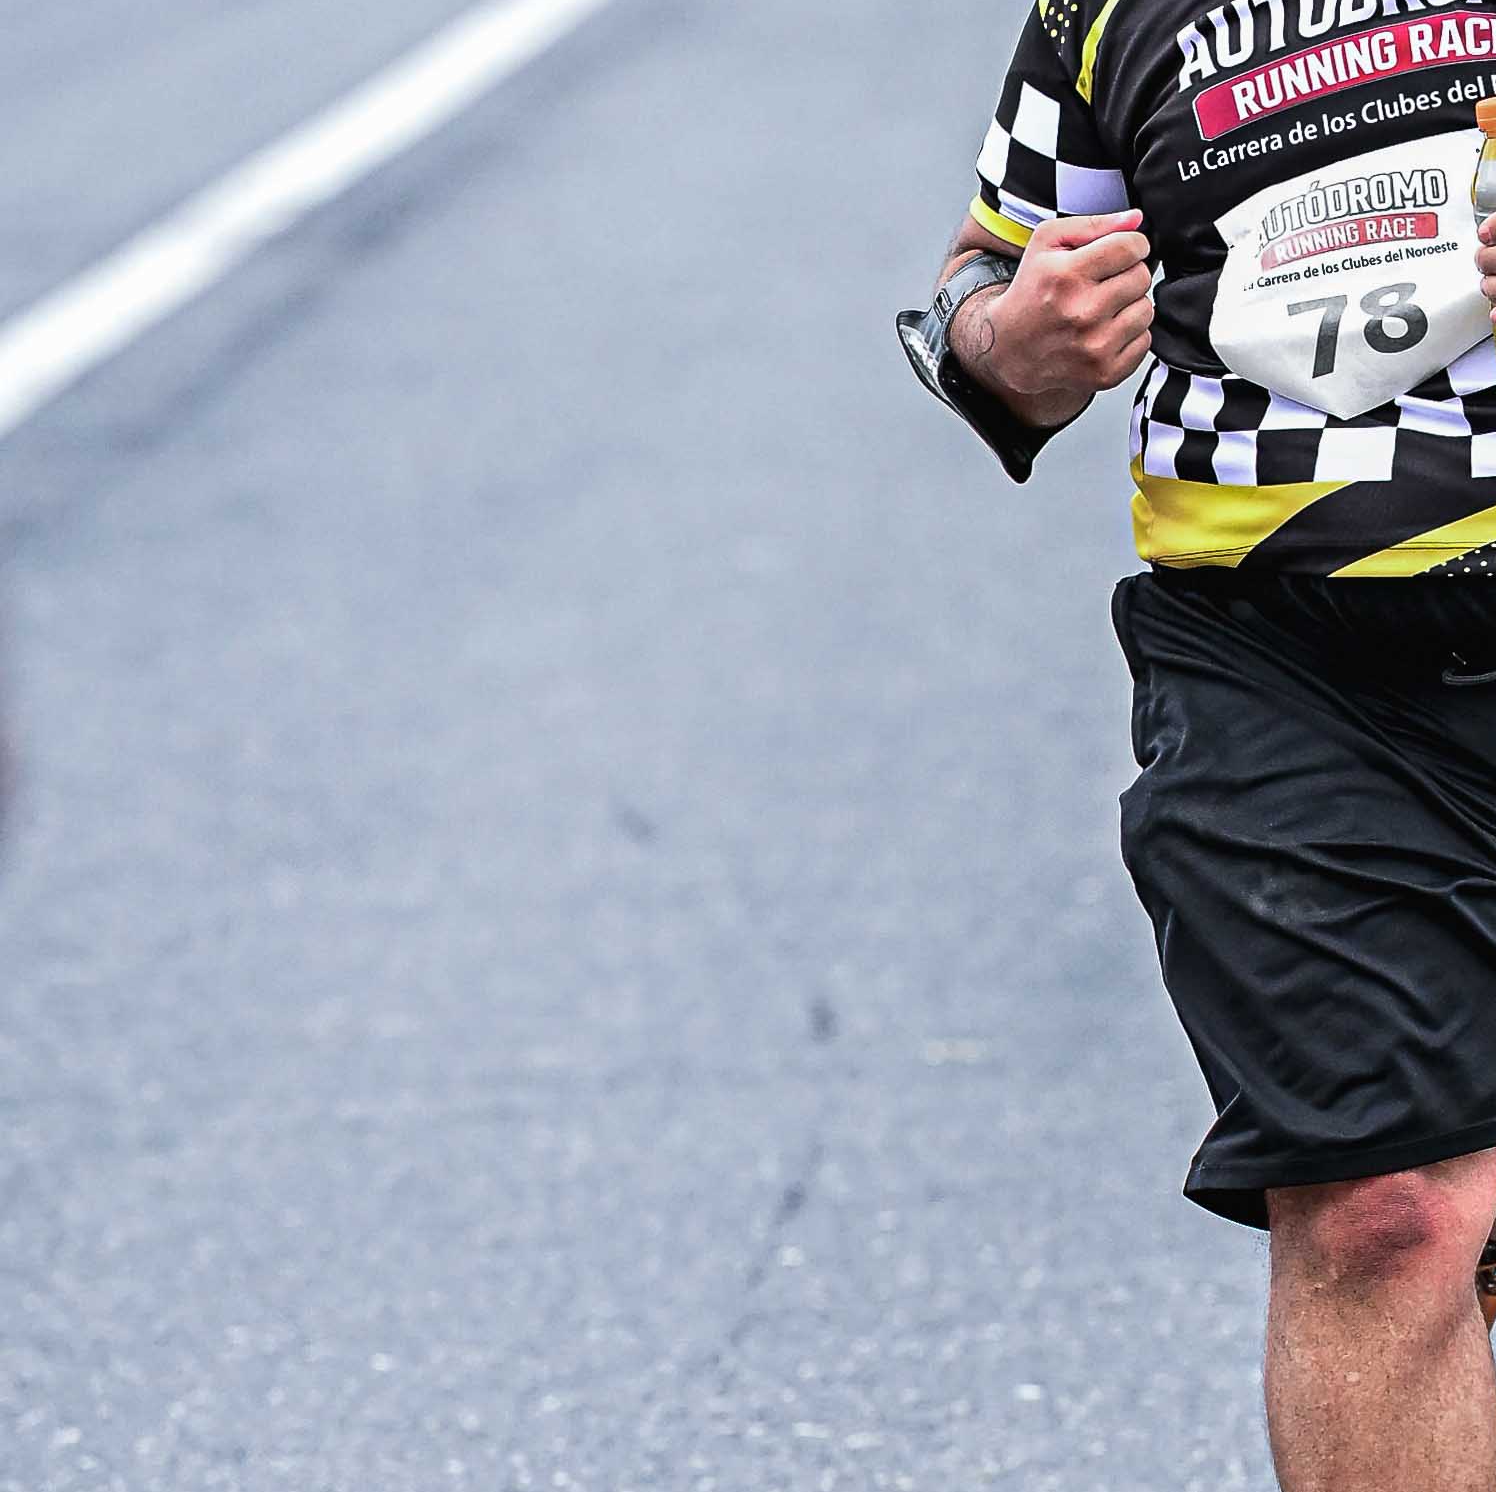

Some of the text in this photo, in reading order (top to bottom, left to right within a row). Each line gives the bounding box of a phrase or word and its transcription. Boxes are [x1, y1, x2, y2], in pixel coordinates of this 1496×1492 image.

[1231, 37, 1398, 121] RUNNING
[1178, 160, 1200, 181] La
[1203, 133, 1283, 170] Carrera
[1289, 120, 1318, 145] de
[1322, 112, 1357, 136] los
[1361, 90, 1442, 124] Clubes
[1447, 76, 1486, 103] del
[1257, 270, 1301, 288] Carrera
[1303, 266, 1320, 279] de
[1321, 262, 1339, 276] los
[1341, 254, 1382, 271] Clubes
[1384, 249, 1404, 263] del
[1406, 241, 1459, 258] Noroeste
[1275, 217, 1417, 264] RUNNING RACE
[1287, 282, 1429, 379] 78
